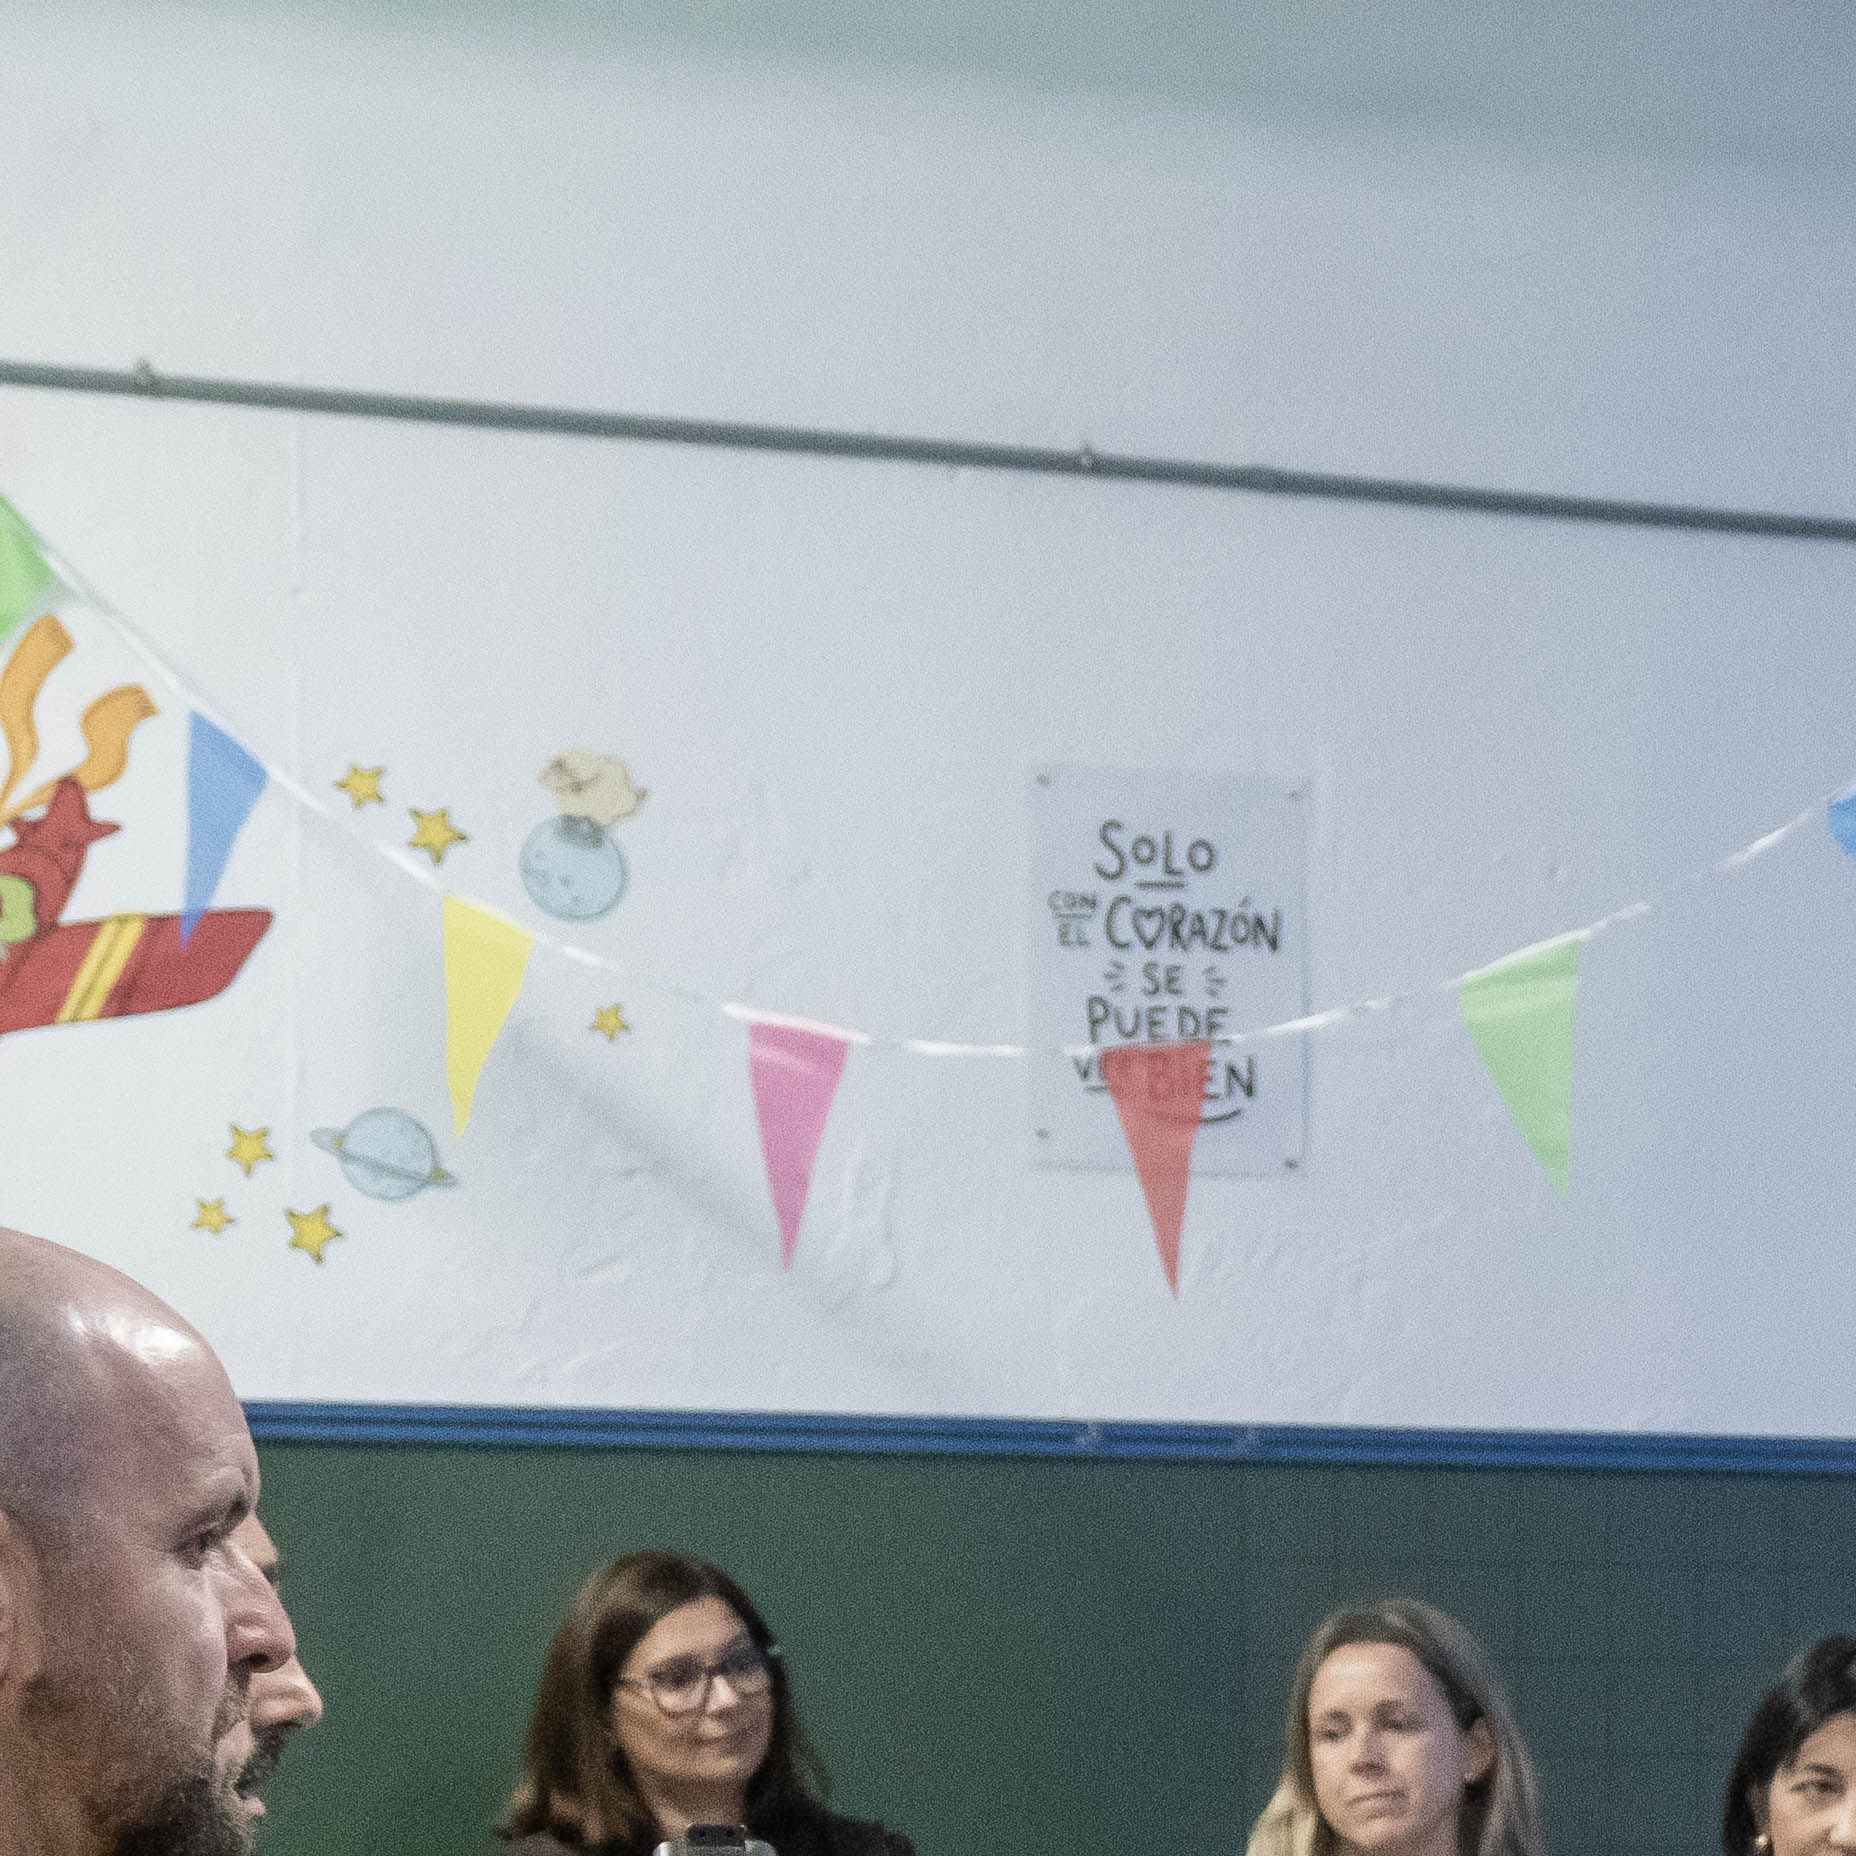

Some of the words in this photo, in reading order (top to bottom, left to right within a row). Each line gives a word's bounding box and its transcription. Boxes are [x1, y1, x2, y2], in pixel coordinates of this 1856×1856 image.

[1094, 819, 1218, 881] SOLO
[1048, 889, 1097, 911] CON
[1058, 920, 1091, 949] EL
[1104, 894, 1284, 953] CORAZÓN
[1142, 961, 1182, 997] SE
[1086, 994, 1230, 1046] PUEDE
